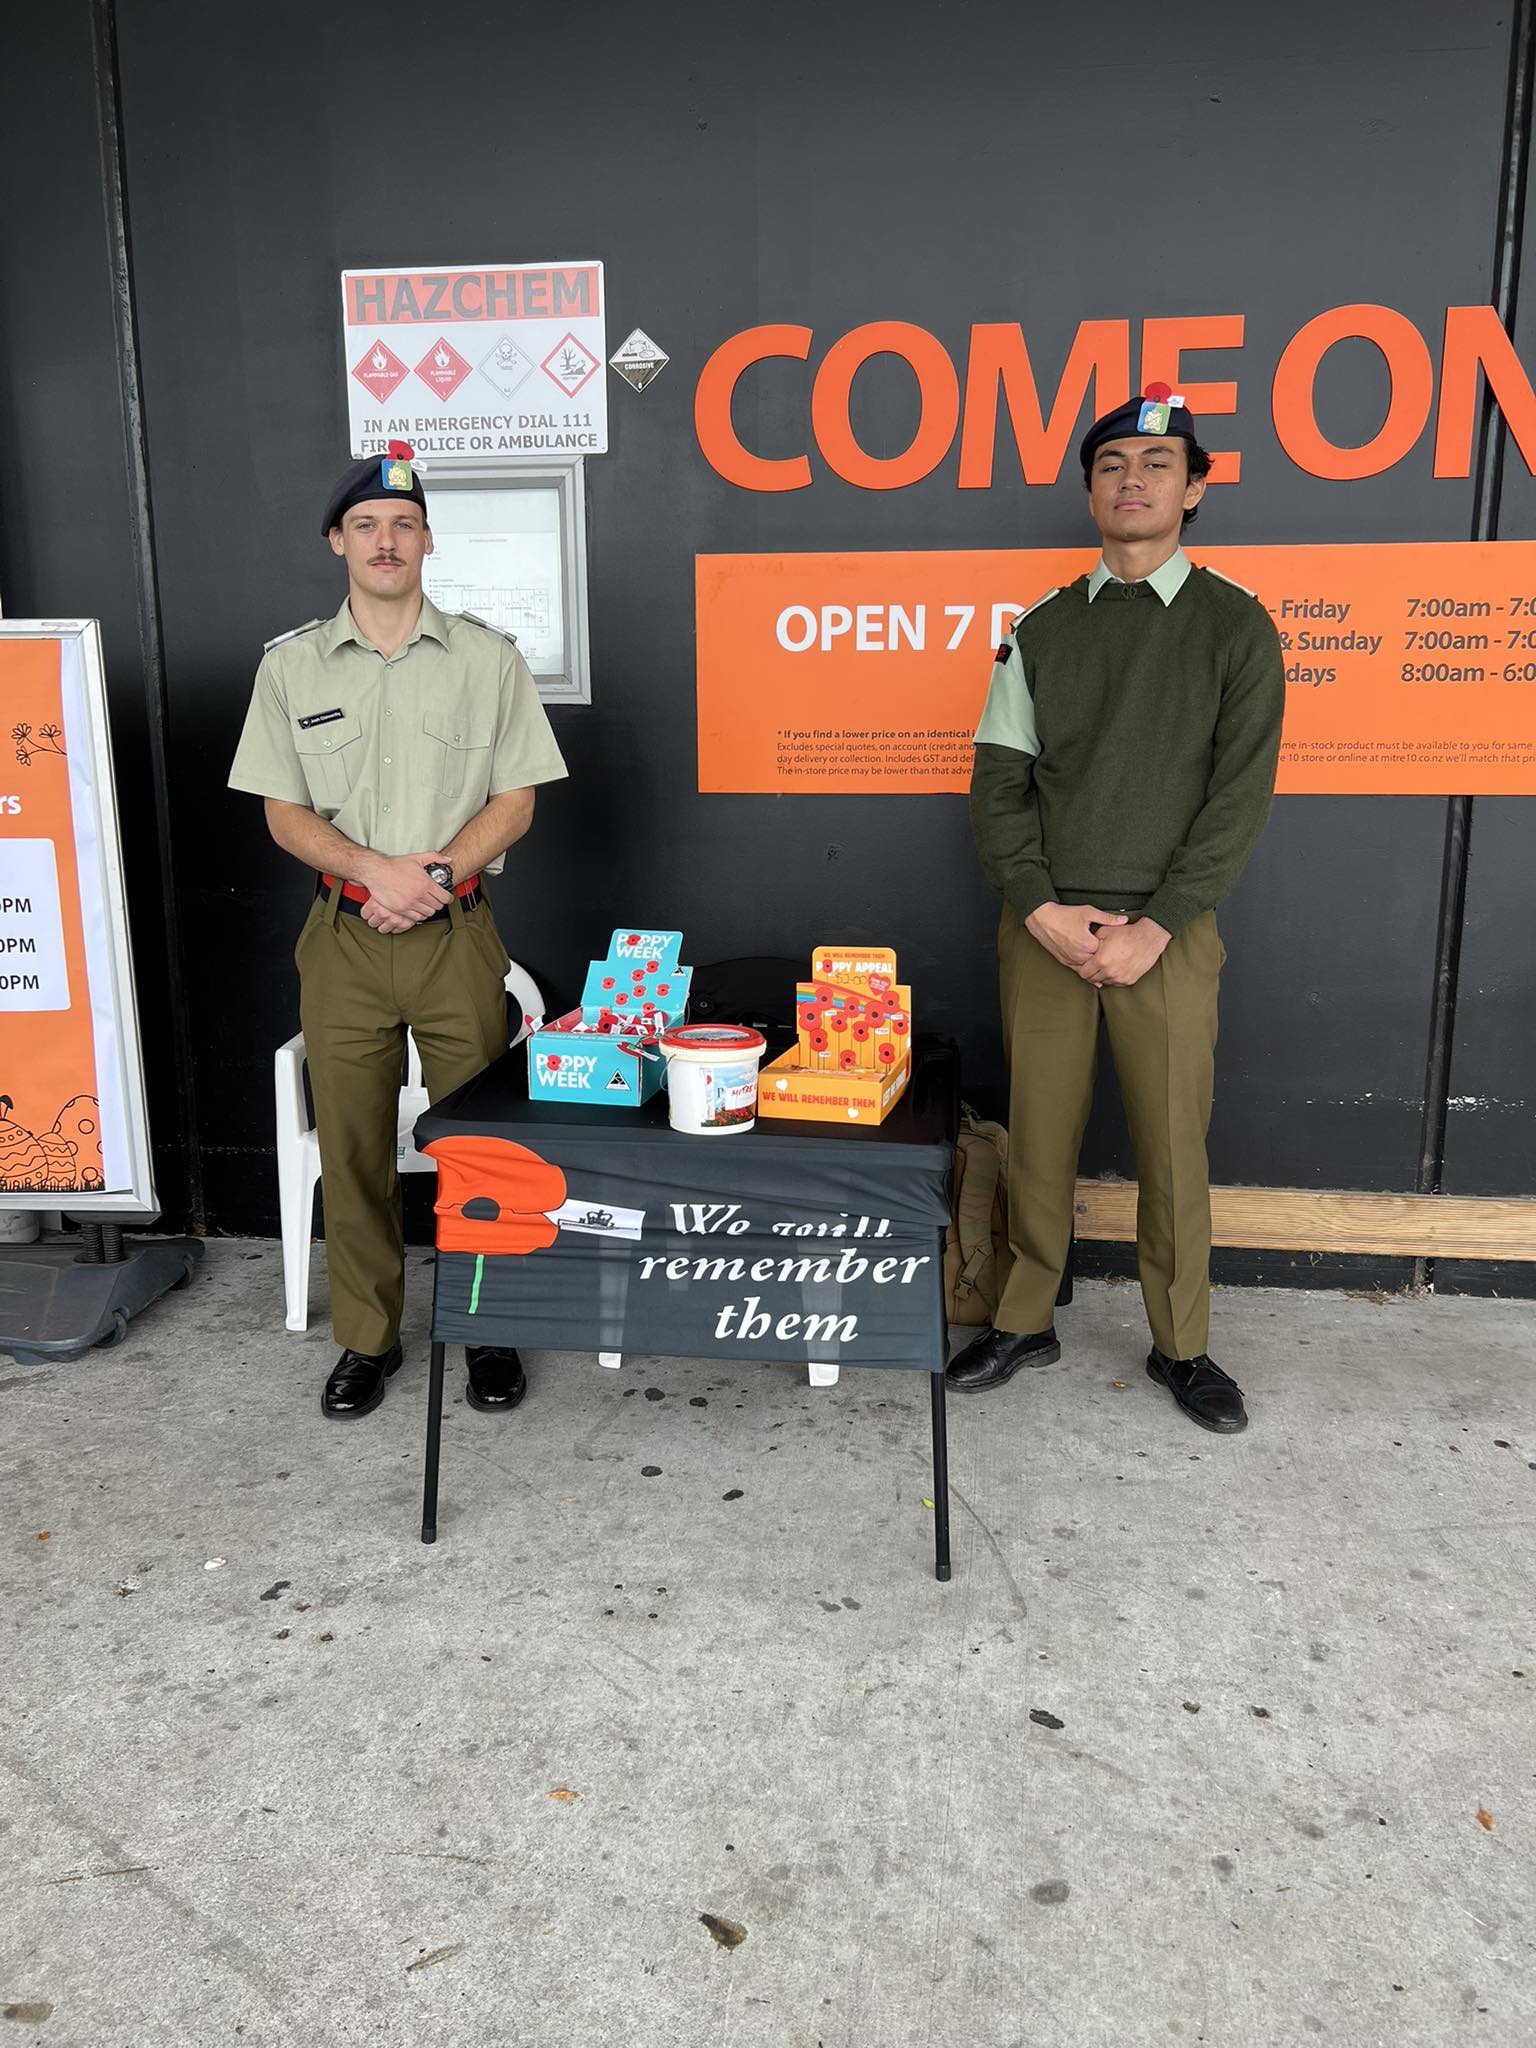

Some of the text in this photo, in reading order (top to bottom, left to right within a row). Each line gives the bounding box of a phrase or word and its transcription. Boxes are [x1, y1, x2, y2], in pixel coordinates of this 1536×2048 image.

[354, 271, 590, 322] HAZCHEM
[624, 361, 655, 370] CORROSIVE
[694, 304, 1536, 491] COME ON
[363, 413, 592, 433] IN AN EMERGENCY DIAL 111
[361, 433, 598, 452] FIR POLICE OR AMBULANCE
[1281, 598, 1351, 624] Friday
[1407, 598, 1491, 617] 7:00am
[776, 604, 926, 652] OPEN
[944, 605, 976, 650] 7
[1297, 630, 1383, 656] Sunday
[1405, 631, 1489, 650] 7:00am
[1285, 663, 1336, 687] days
[1401, 663, 1485, 682] 8:00am
[784, 730, 792, 738] If
[792, 732, 811, 741] you
[813, 730, 833, 738] find
[842, 730, 870, 738] lower
[871, 731, 896, 741] price
[927, 729, 969, 738] identical
[777, 743, 813, 751] Excludes
[815, 743, 846, 753] special
[892, 743, 927, 751] account
[929, 742, 956, 752] (credit
[1298, 741, 1334, 749] in-stock
[1337, 741, 1374, 751] product
[1402, 741, 1414, 749] be
[1416, 741, 1458, 749] available
[1460, 741, 1470, 749] to
[1471, 743, 1489, 751] you
[1492, 741, 1505, 749] for
[777, 755, 793, 765] day
[794, 755, 827, 765] delivery
[885, 755, 921, 763] Includes
[923, 754, 939, 763] GST
[941, 754, 958, 762] and
[959, 754, 974, 762] del
[1301, 754, 1324, 762] store
[1339, 754, 1367, 762] online
[1381, 753, 1443, 763] mitre10.co.nz
[1469, 753, 1499, 762] match
[1501, 753, 1521, 762] that
[1522, 754, 1536, 764] pri
[777, 766, 972, 777] The in-store price may be lower than that adve
[0, 898, 32, 914] PM
[616, 945, 665, 960] WEEK
[855, 961, 894, 974] APPEAL
[537, 1070, 592, 1089] WEEK
[762, 1091, 876, 1109] WE WILL REMEMBER THEM
[669, 1203, 751, 1236] We
[638, 1248, 931, 1285] remember
[714, 1296, 859, 1342] them
